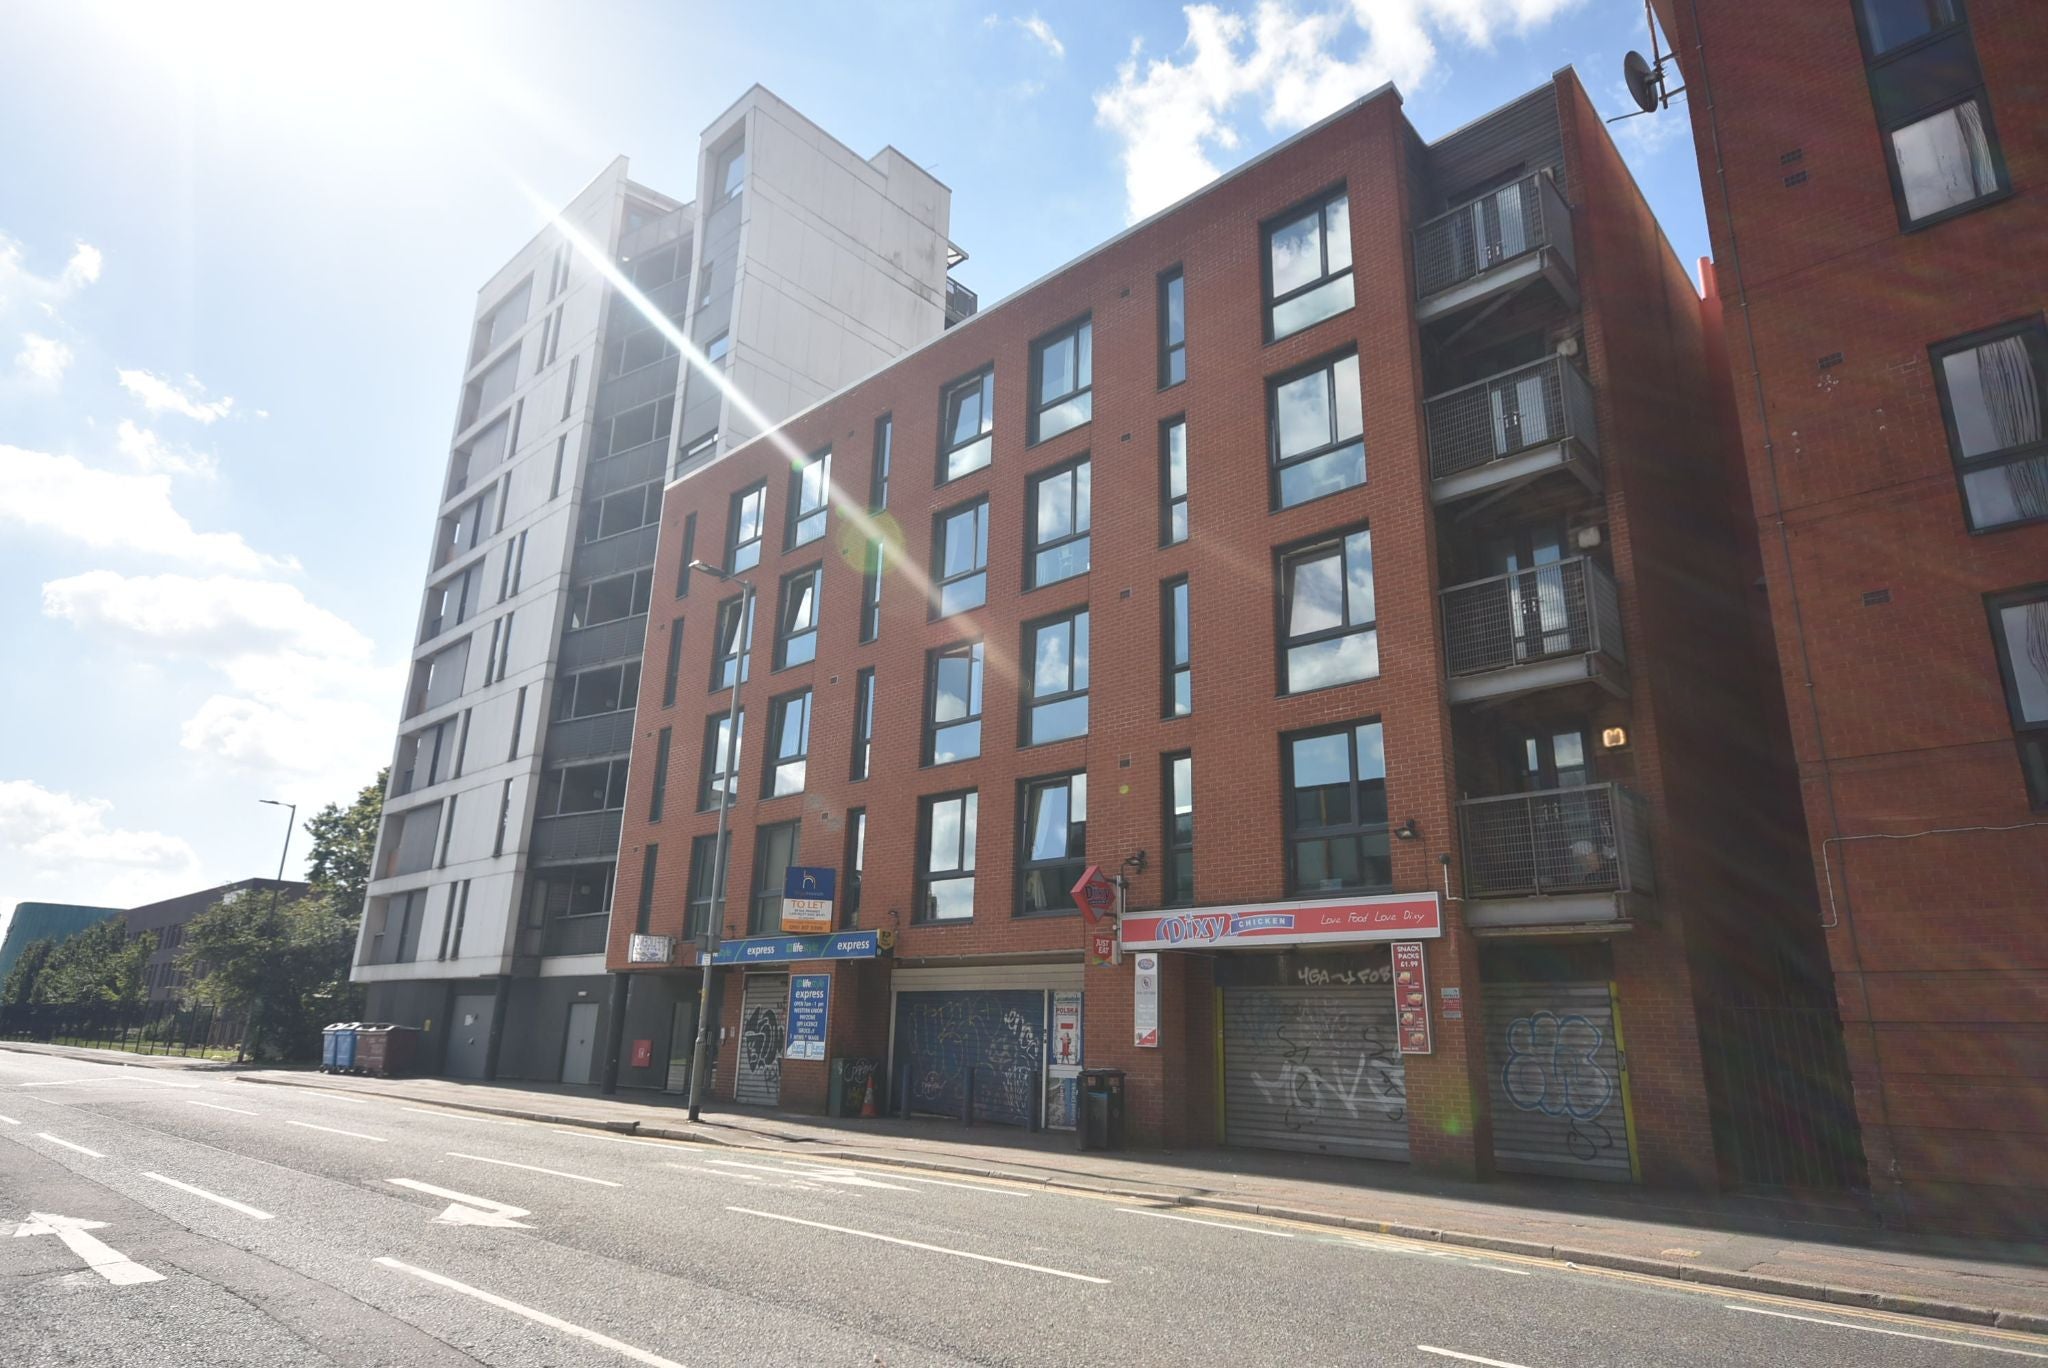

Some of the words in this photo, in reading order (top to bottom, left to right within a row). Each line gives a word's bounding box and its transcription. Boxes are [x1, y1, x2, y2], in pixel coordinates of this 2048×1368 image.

[791, 900, 804, 908] TO
[808, 900, 825, 909] LET
[1238, 917, 1286, 928] CHICKEN
[1320, 914, 1341, 925] Love
[1347, 911, 1369, 923] Food
[1374, 911, 1397, 922] Love
[1403, 909, 1425, 924] Dixy
[1164, 911, 1225, 944] Dixy
[837, 940, 869, 953] express
[1096, 939, 1109, 947] JUST
[747, 945, 775, 957] express
[795, 990, 824, 1001] express
